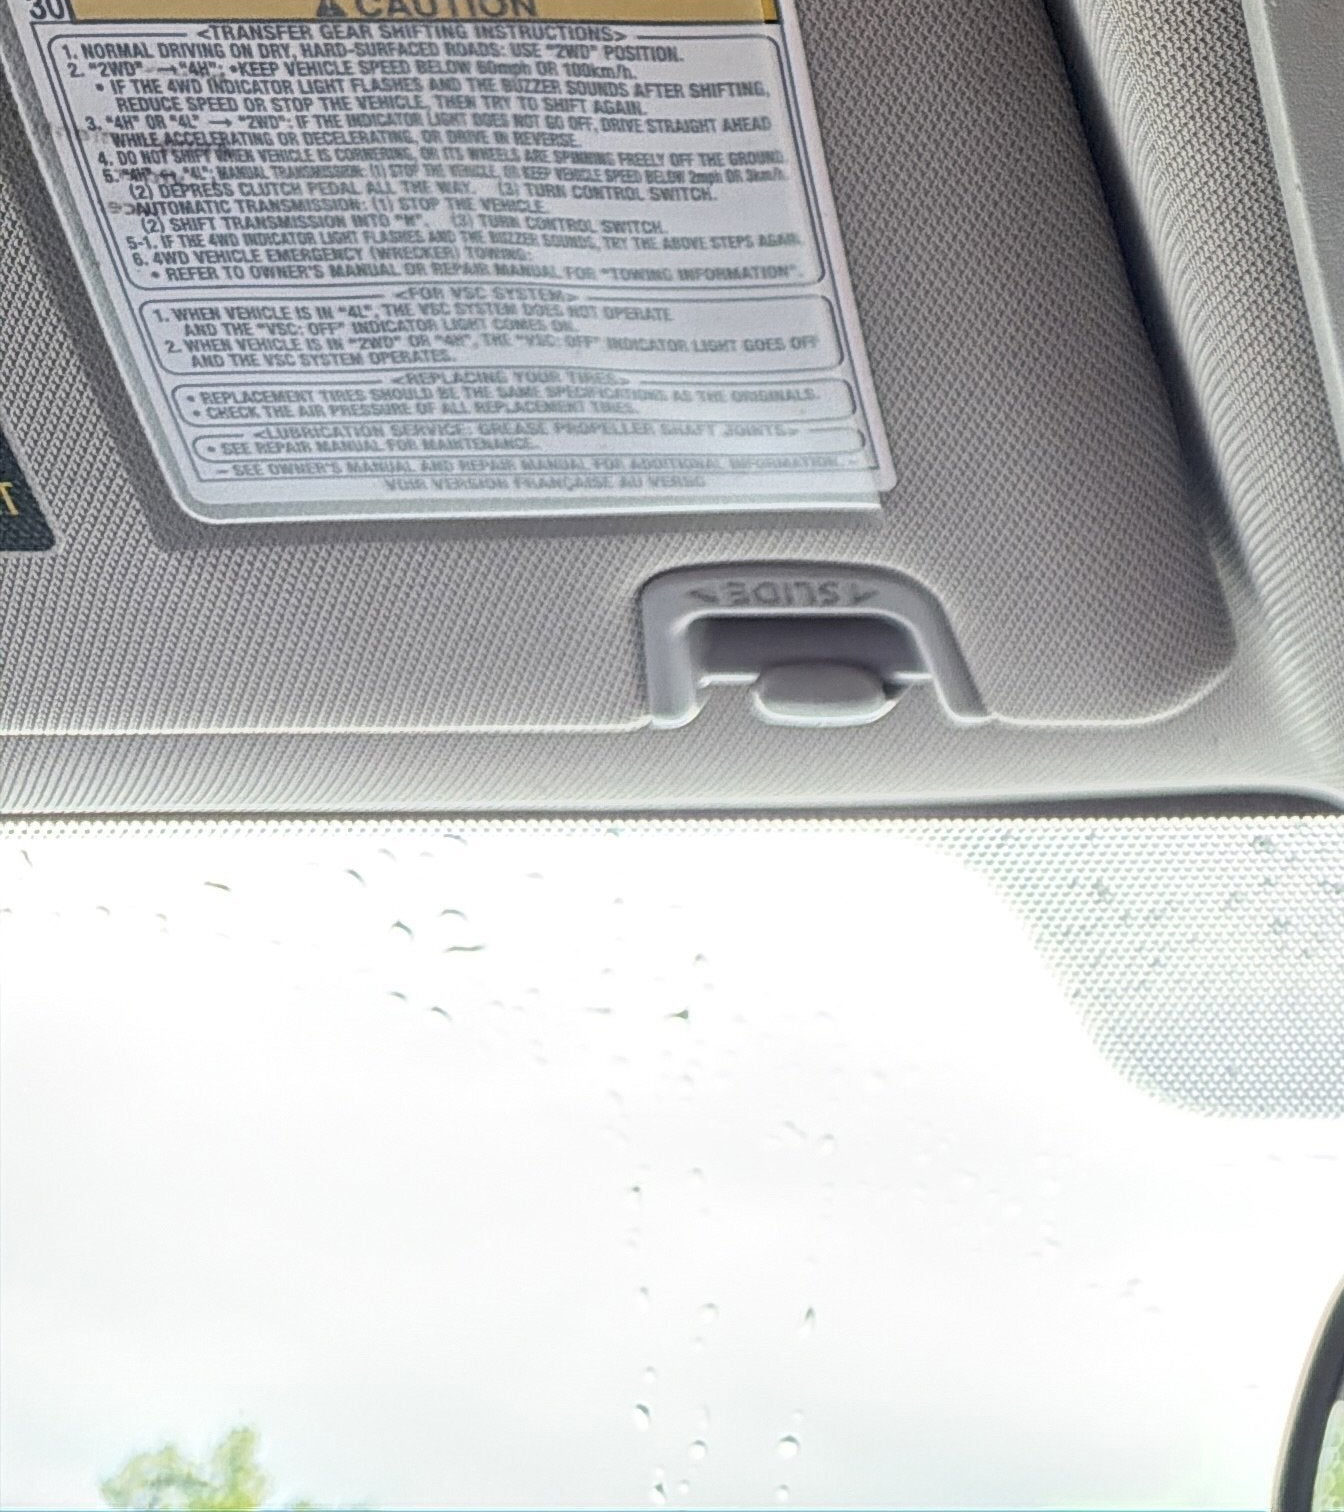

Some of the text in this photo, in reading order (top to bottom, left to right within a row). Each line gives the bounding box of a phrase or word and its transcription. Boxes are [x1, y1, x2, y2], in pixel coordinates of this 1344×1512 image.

[320, 24, 468, 41] GEAR SHIFTING
[62, 42, 685, 63] 1. NORMAL DRIVING ON DRY, HARD-SURFACED USE "2WD" POSITION.
[67, 60, 559, 78] 2. "2WD" VEHICLE SPEED BELOW OR
[110, 78, 771, 99] IF THE 4WD INDICATOR LIGHT FLASHES AND THE BUZZER SOUNDS AFTER SHIFTING,
[116, 95, 647, 116] REDUCE SPEED OR STOP THE THEN TRY TO SHIFT AGAIN.
[85, 112, 772, 134] 3. OR IF THE INDICATOR LIGHT DOES NOT GO DRIVE STRAIGHT AHEAD
[111, 129, 511, 148] WHILE ACCELERATING OR OR DRIVE IN
[98, 148, 726, 168] 4. DO NOT SHIFT WHEN VEHICLE IS ARE FREELY OFF THE
[605, 168, 643, 184] SPEED
[129, 180, 718, 202] (2) DEPRESS CLUTCH PEDAL ALL THE TURN CONTROL SWITCH.
[137, 197, 476, 217] AUTOMATIC STOP THE
[142, 213, 599, 234] (2) SHIFT TRANSMISSION INTO TURN CONTROL
[160, 230, 754, 251] IF THE 4WD INDICATOR LIGHT FLASHES AND THE TRY THE ABOVE STEPS
[133, 247, 364, 267] 6. 4WD VEHICLE EMERGENCY
[166, 262, 597, 282] REFER TO OWNER'S MANUAL OR REPAIR MANUAL FOR
[153, 302, 518, 323] 1. WHEN VEHICLE IS IN THE SYSTEM
[185, 319, 437, 337] AND THE INDICATOR
[183, 334, 818, 353] WHEN VEHICLE IS IN OR GOES OFF
[192, 352, 362, 369] AND THE VSC SYSTEM
[199, 386, 434, 404] REPLACEMENT TIRES SHOULD
[206, 400, 470, 420] CHECK THE AIR PRESSURE OF ALL
[222, 438, 384, 456] SEE REPAIR MANUAL
[724, 581, 841, 605] SLIDE
